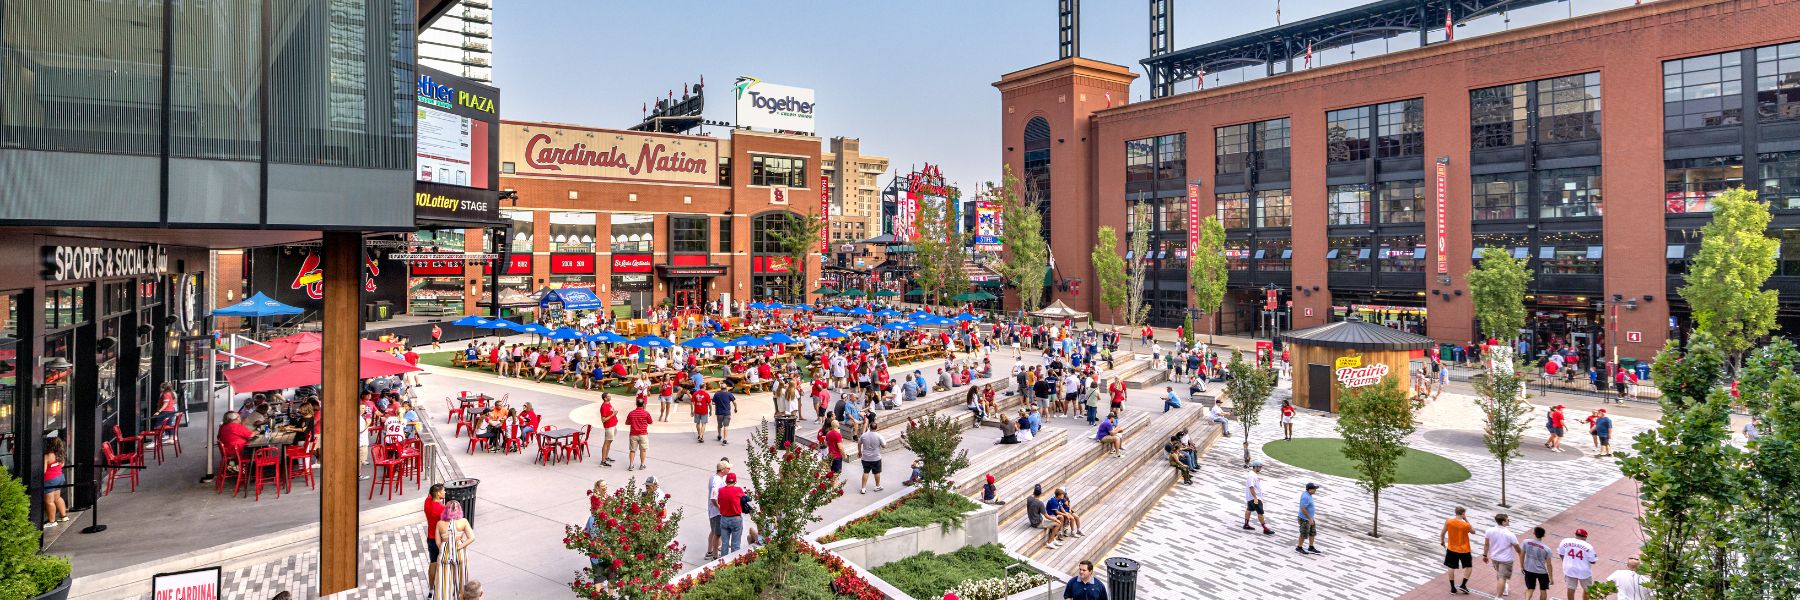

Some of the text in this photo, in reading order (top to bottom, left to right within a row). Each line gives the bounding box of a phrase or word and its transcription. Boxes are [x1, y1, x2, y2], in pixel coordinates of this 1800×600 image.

[458, 90, 495, 114] PLAZA
[748, 91, 815, 114] Together
[524, 133, 708, 175] Cardinals Nation
[461, 200, 488, 211] STAGE
[55, 245, 104, 281] SPORTS
[106, 247, 113, 277] &
[115, 248, 146, 276] SOCIAL
[1630, 333, 1637, 341] 4
[1338, 365, 1387, 380] Prairie
[1346, 377, 1379, 386] Farms
[1568, 549, 1583, 560] 44
[176, 583, 216, 600] CARDINAL
